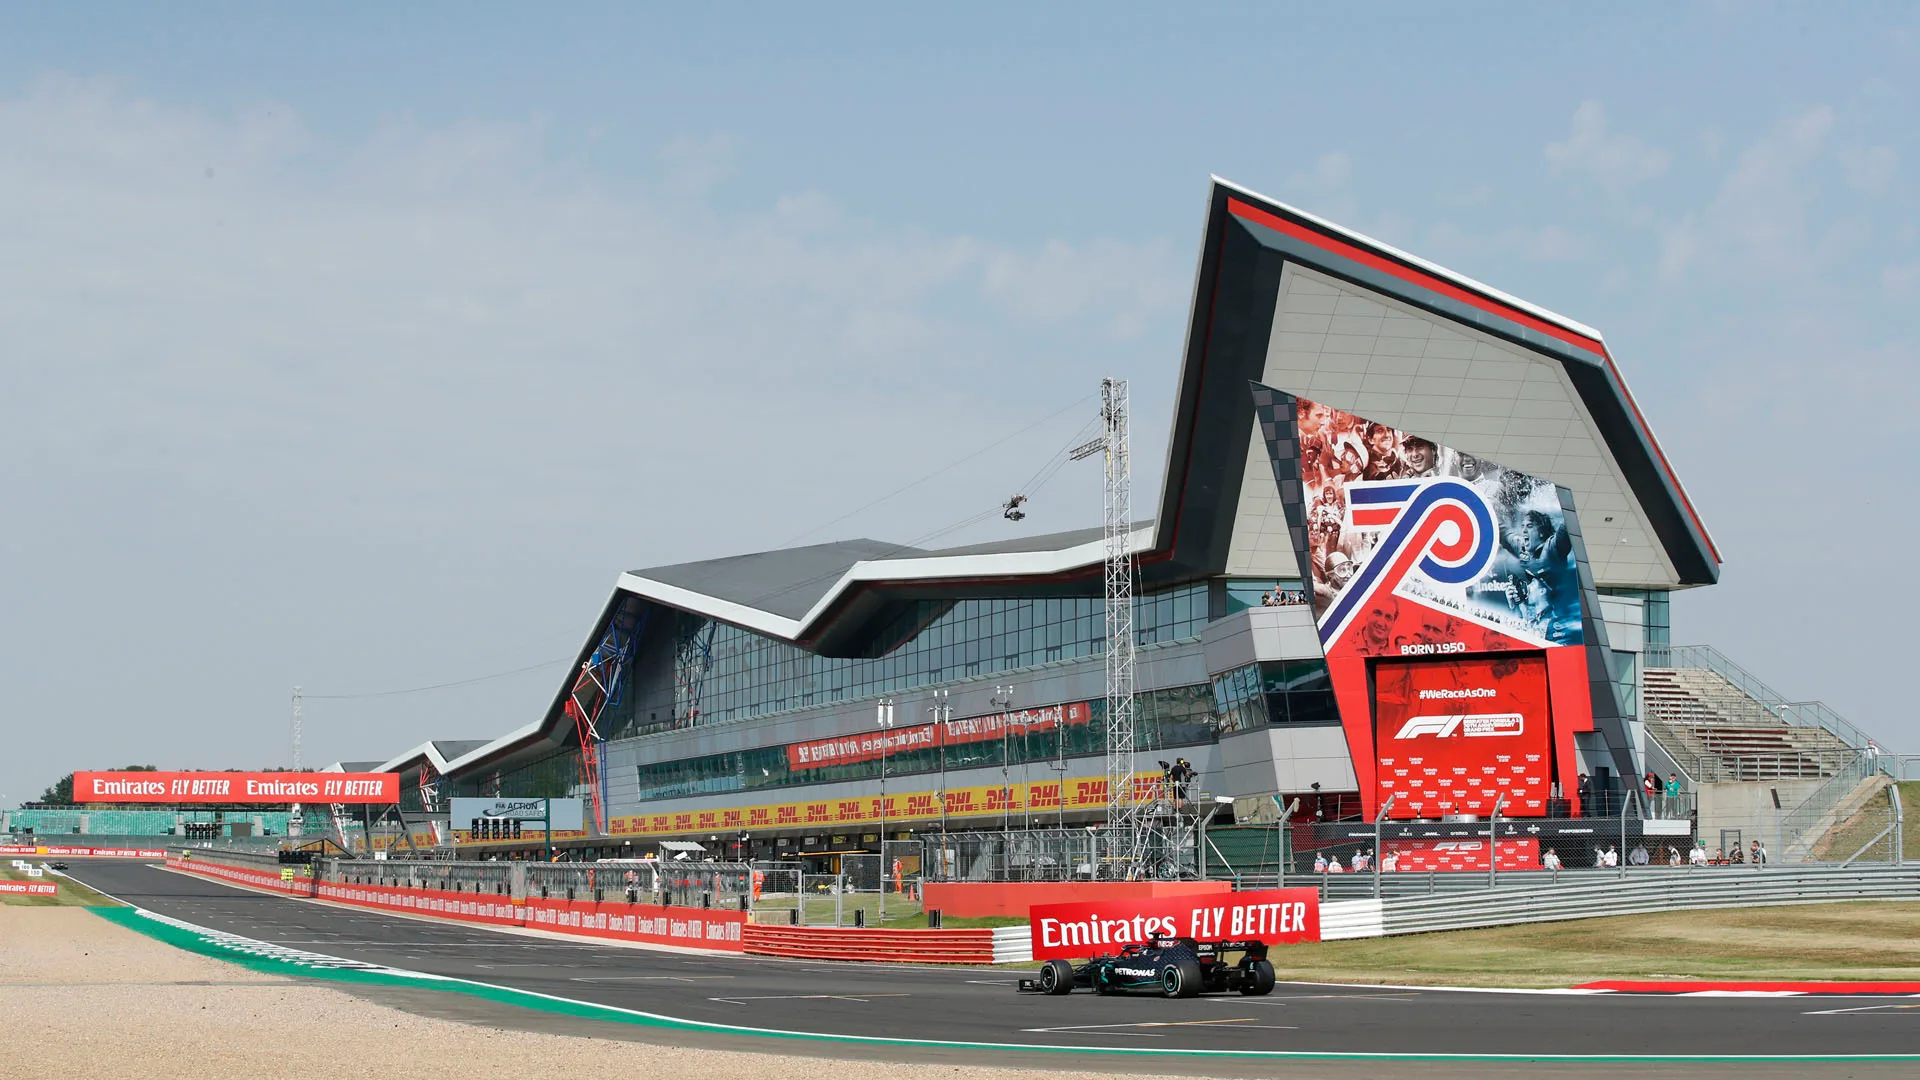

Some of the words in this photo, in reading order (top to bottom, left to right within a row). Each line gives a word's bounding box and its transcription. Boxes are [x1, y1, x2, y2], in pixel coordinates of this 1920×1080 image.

[1401, 644, 1434, 655] BORN
[1436, 642, 1466, 653] 1950
[1419, 688, 1496, 699] #WeRaceAsOne
[93, 778, 165, 795] Emirates
[171, 780, 190, 795] FLY
[191, 779, 230, 795] BETTER
[246, 779, 318, 796] Emirates
[324, 780, 344, 796] FLY
[345, 780, 383, 796] BETTER
[508, 802, 538, 810] ACTION
[699, 813, 718, 829] DHL
[724, 811, 743, 827] DHL
[750, 809, 770, 825] DHL
[778, 806, 798, 823] DHL
[807, 804, 829, 822] DHL
[839, 802, 863, 820] DHL
[872, 799, 898, 817] DHL
[907, 796, 935, 815] DHL
[945, 792, 974, 813] DHL
[986, 788, 1017, 809] DHL
[1030, 785, 1062, 807] DHL
[0, 884, 26, 892] mirates
[1040, 914, 1177, 947] Emirates
[1190, 908, 1226, 938] FLY
[1231, 902, 1306, 935] BETTER
[1114, 967, 1156, 977] PETRONAS
